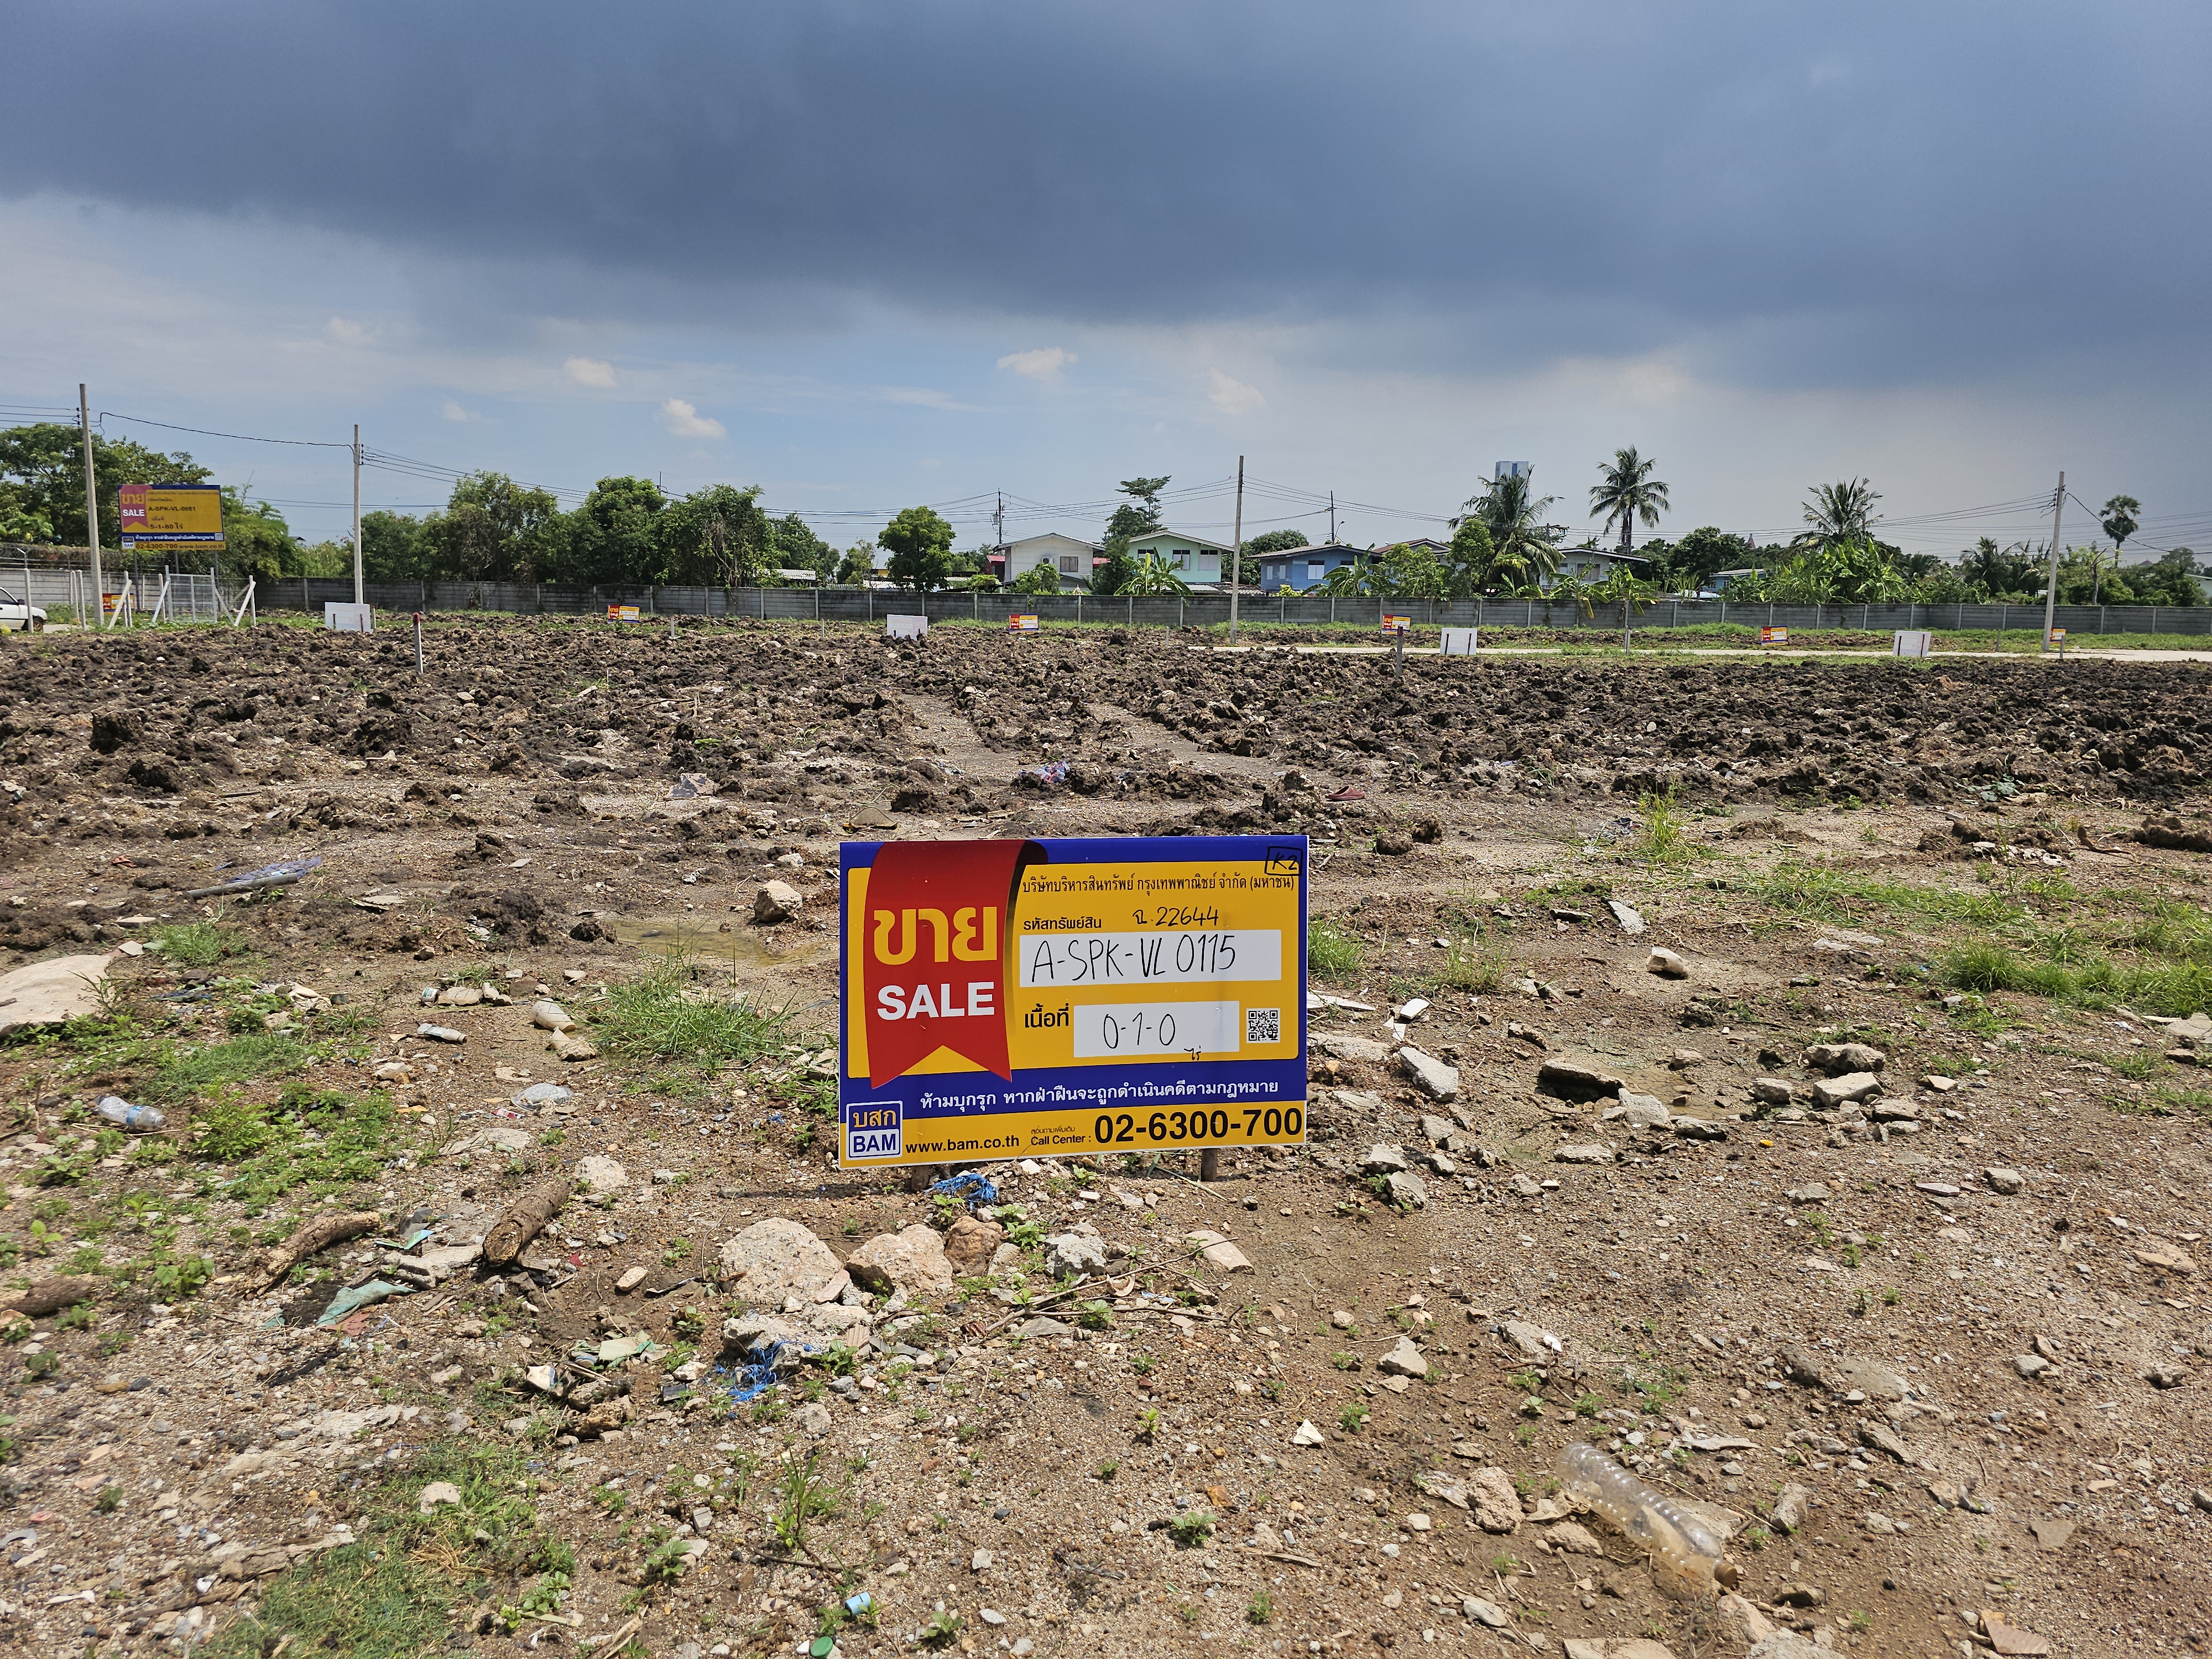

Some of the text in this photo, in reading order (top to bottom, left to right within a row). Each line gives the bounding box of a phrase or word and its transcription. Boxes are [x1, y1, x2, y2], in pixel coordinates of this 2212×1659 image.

[1272, 852, 1298, 870] K2
[1022, 872, 1295, 896] บริษัทบริหารสินทรัพย์ กรุงเทพพาณิชย์ จำกัด (มหาชน)
[1024, 916, 1102, 930] รหัสทรัพย์สิน
[874, 906, 997, 966] ขาย
[877, 981, 995, 1020] SALE
[1024, 1003, 1069, 1028] เนื้อที่
[1103, 1011, 1176, 1049] 0-1-0
[920, 1079, 1279, 1112] ห้ามบุกรุก หากฝ่าฝืนจะถูกดำเนินคดีตามกฎหมาย
[852, 1109, 896, 1128] บสก
[1031, 1136, 1050, 1146] Call
[1052, 1135, 1086, 1144] Center
[1094, 1107, 1302, 1144] 02-6300-700
[853, 1133, 896, 1153] BAM
[905, 1135, 1019, 1153] www.bam.co.th
